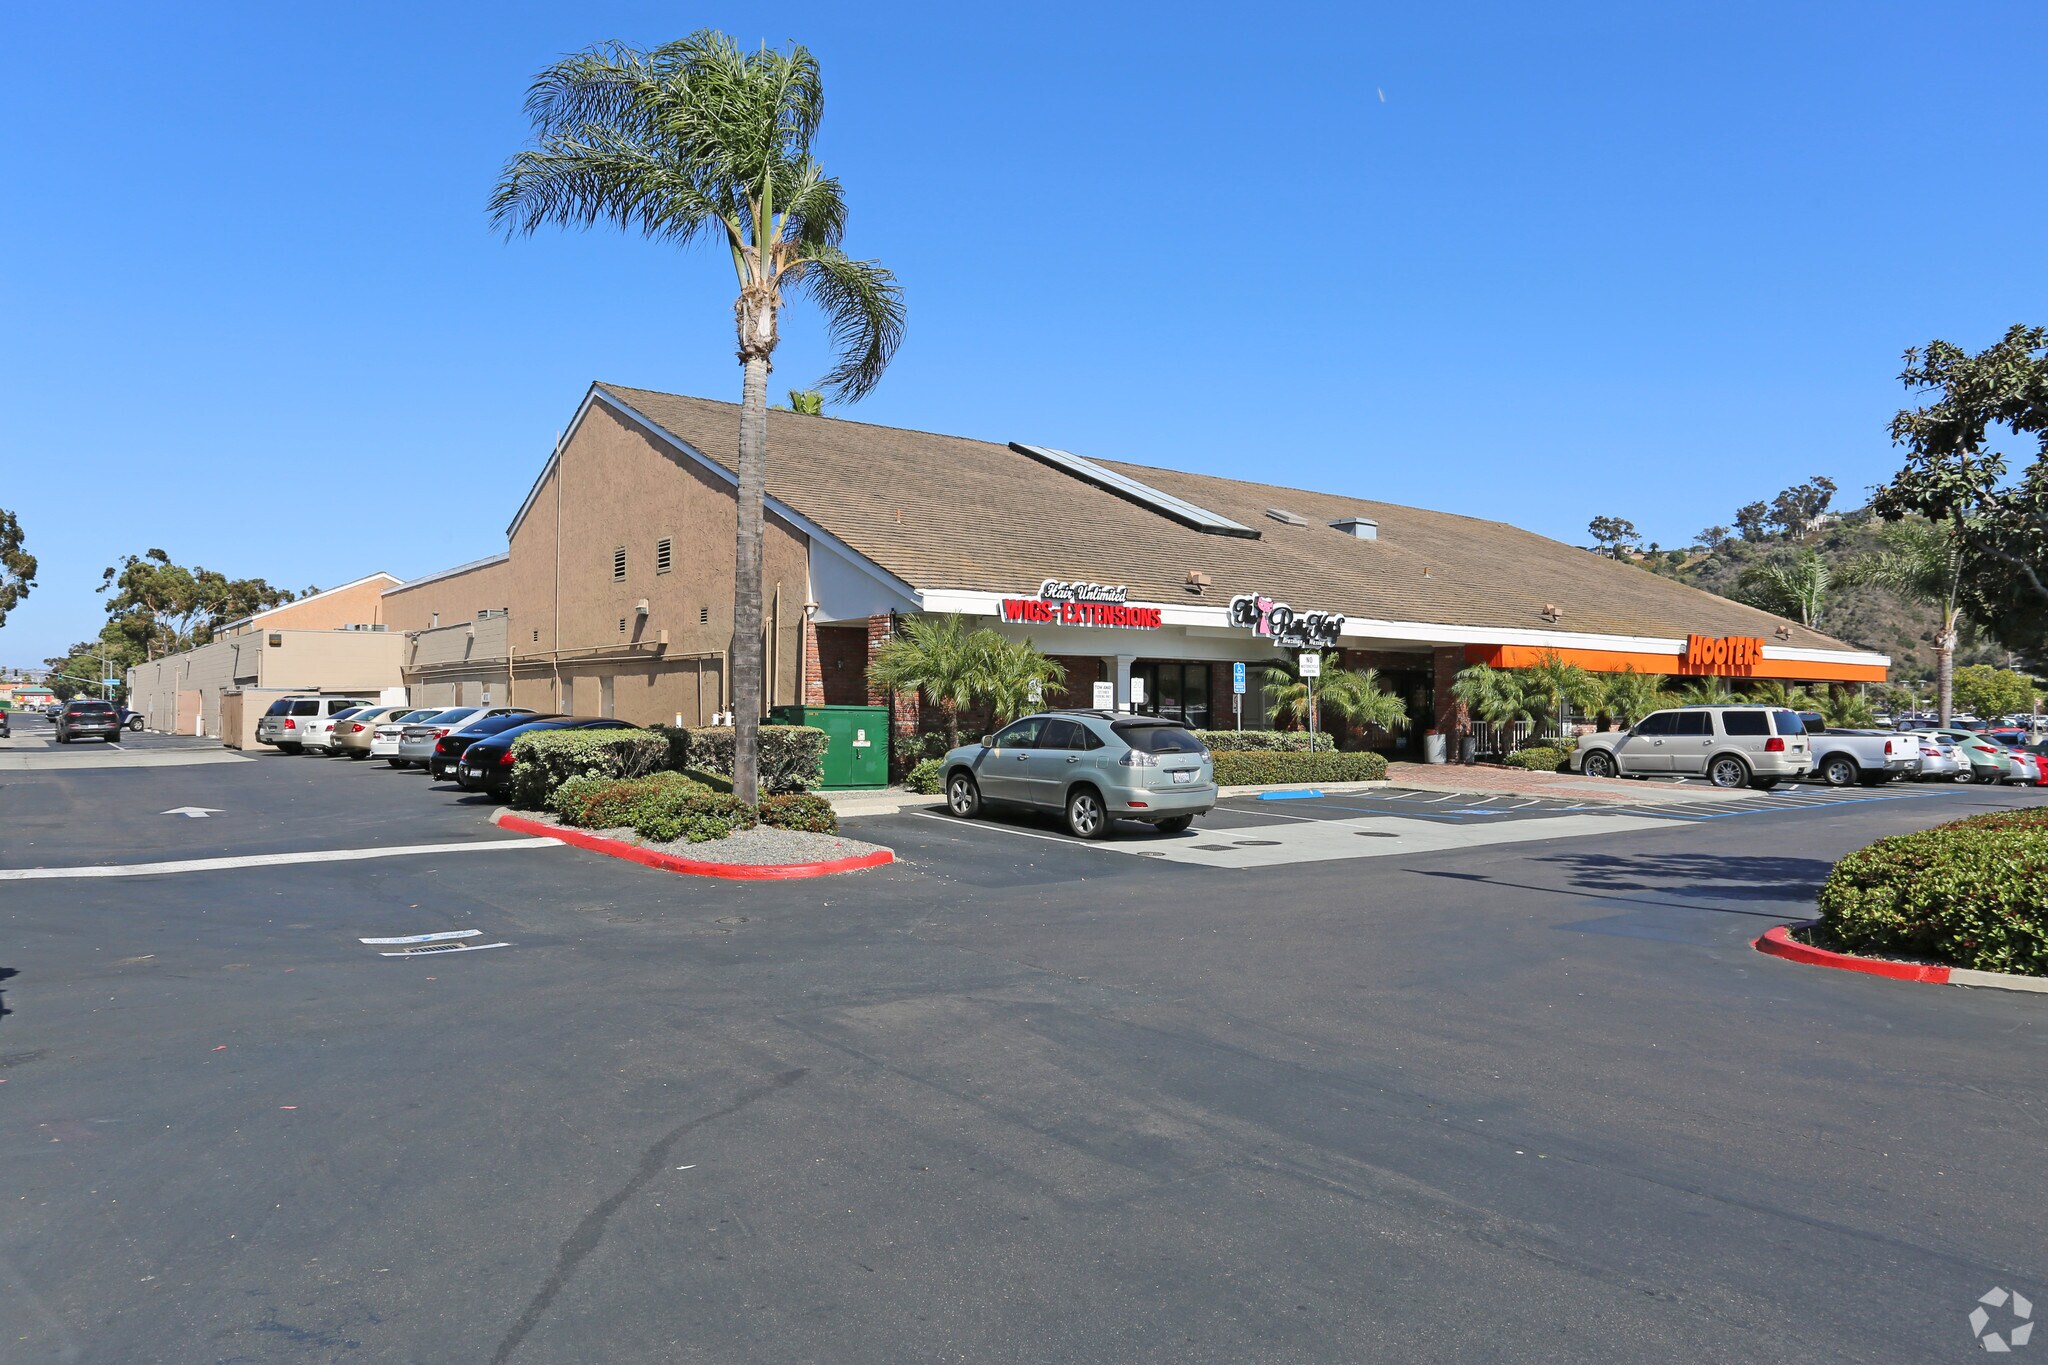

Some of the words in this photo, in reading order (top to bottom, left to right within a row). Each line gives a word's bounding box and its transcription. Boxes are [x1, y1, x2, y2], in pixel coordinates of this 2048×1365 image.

[1044, 583, 1074, 600] Hair
[1077, 585, 1128, 603] Unlimited
[1687, 633, 1766, 666] HOOTERS
[1133, 680, 1143, 689] 20
